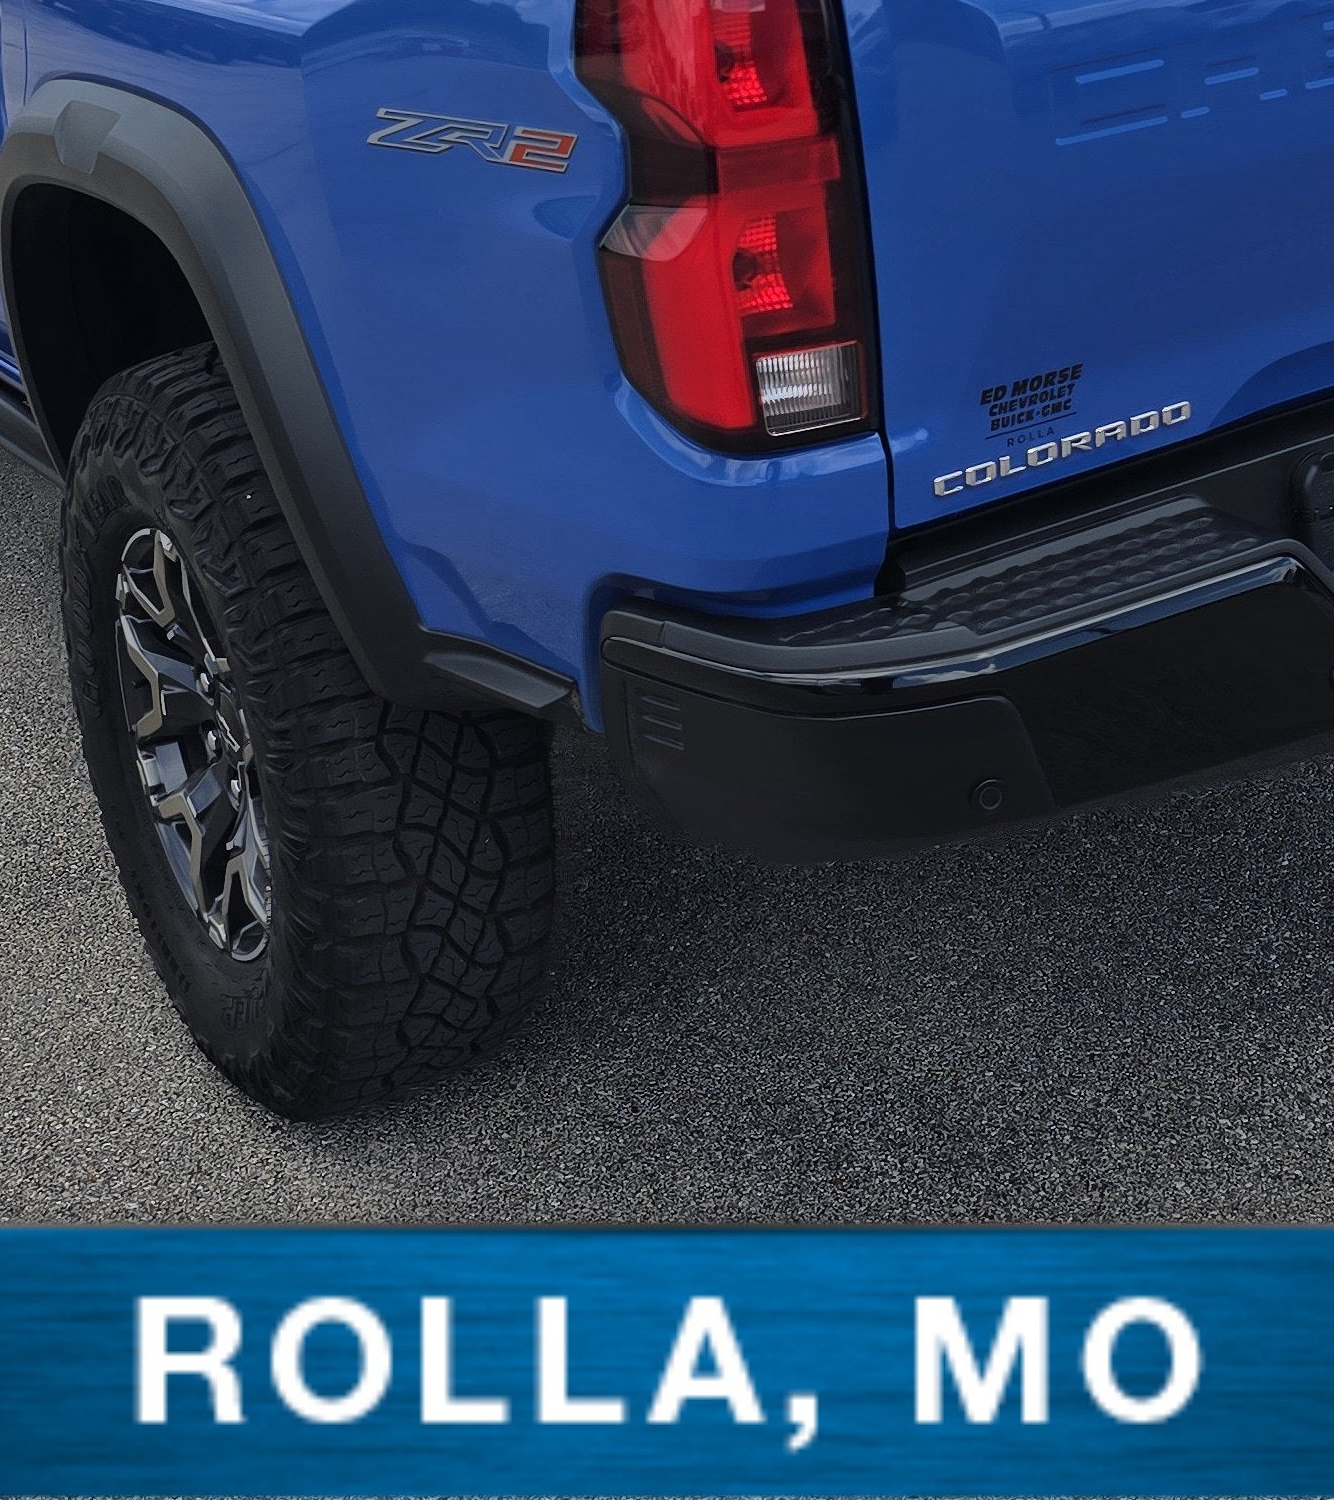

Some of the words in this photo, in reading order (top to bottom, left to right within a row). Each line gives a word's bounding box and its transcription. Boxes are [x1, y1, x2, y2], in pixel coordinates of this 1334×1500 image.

[366, 107, 579, 173] ZR2
[980, 384, 1007, 406] ED
[1011, 363, 1083, 398] MORSE
[989, 382, 1076, 417] CHEVROLET
[933, 400, 1191, 497] COLORADO
[1006, 426, 1056, 448] ROLLA
